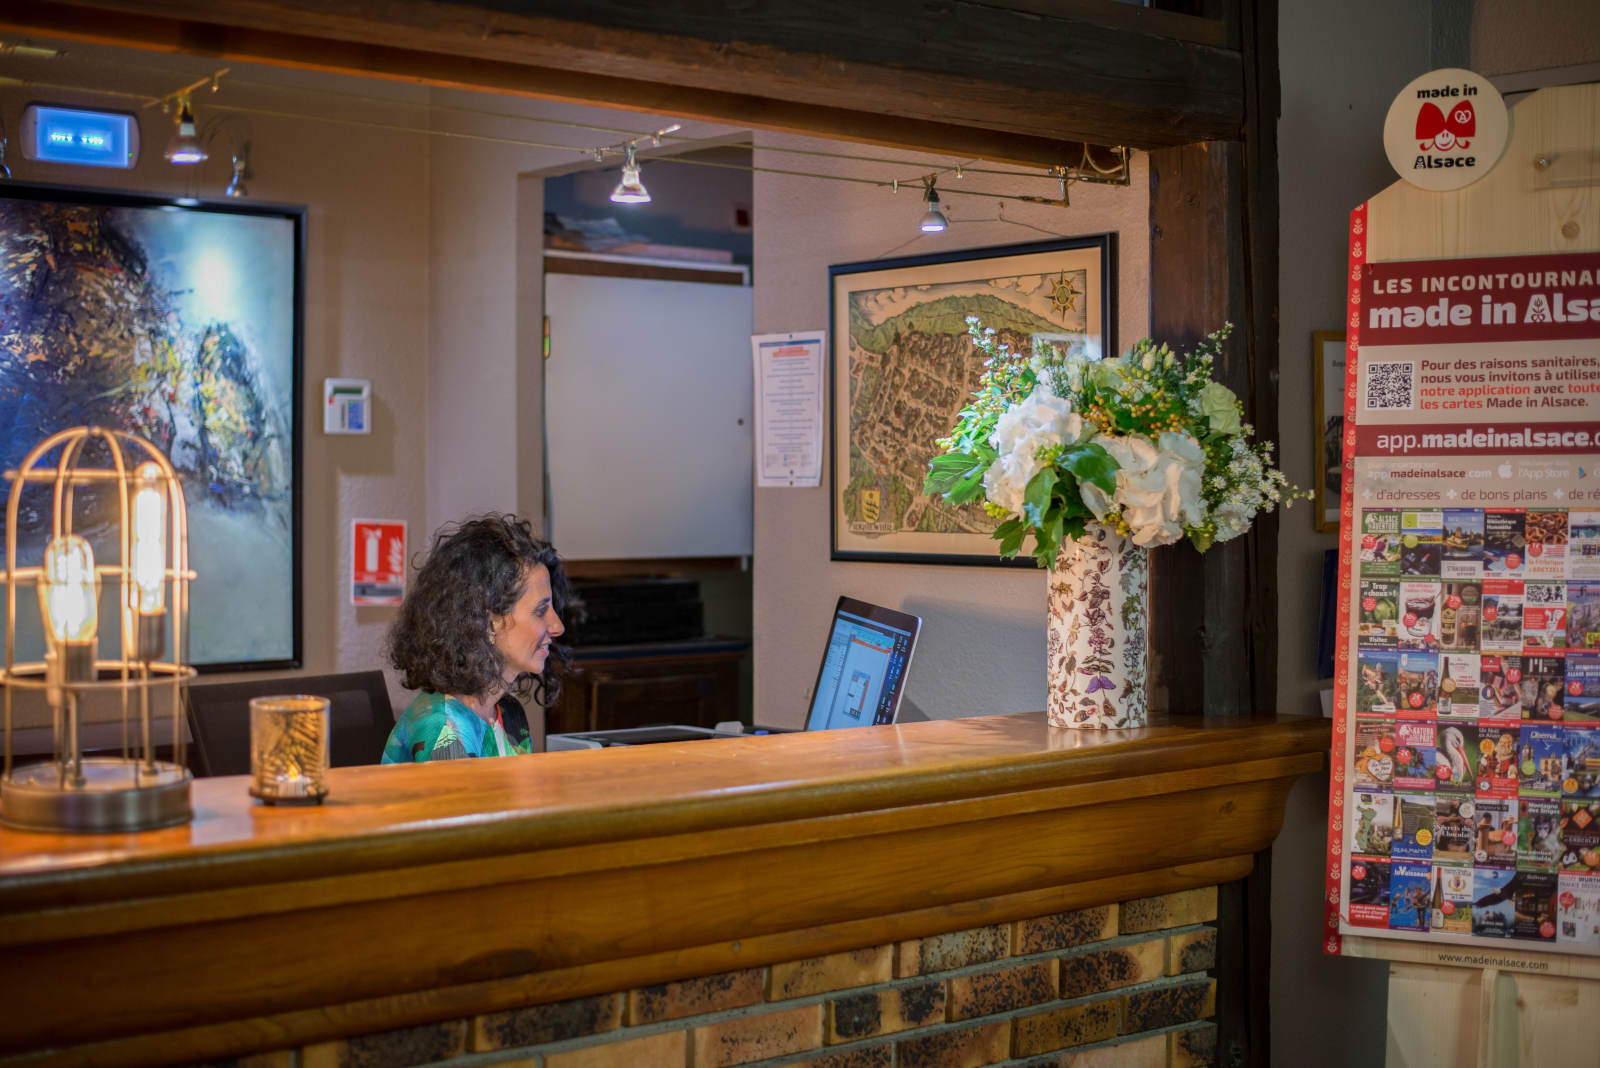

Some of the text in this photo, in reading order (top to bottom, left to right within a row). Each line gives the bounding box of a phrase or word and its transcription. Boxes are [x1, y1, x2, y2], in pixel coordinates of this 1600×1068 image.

[1416, 84, 1478, 99] made in
[1413, 156, 1476, 170] Alsace
[1373, 269, 1600, 294] LES INCONTOURNA
[1369, 297, 1473, 329] made
[1481, 294, 1516, 325] in
[1421, 355, 1600, 370] Pour des raisons sanitaires,
[1421, 374, 1451, 383] nous
[1455, 373, 1486, 383] vous
[1489, 371, 1540, 382] invitons
[1545, 369, 1552, 380] à
[1420, 386, 1455, 396] notre
[1458, 384, 1531, 398] application
[1533, 385, 1564, 394] avec
[1420, 396, 1589, 409] les cartes Made in Alsace.
[1376, 488, 1441, 500] d'adresses
[1460, 489, 1476, 500] de
[1480, 489, 1510, 500] bons
[1513, 488, 1548, 502] plans
[1568, 488, 1584, 500] de
[1438, 953, 1549, 970] www.madeinalsace.com
